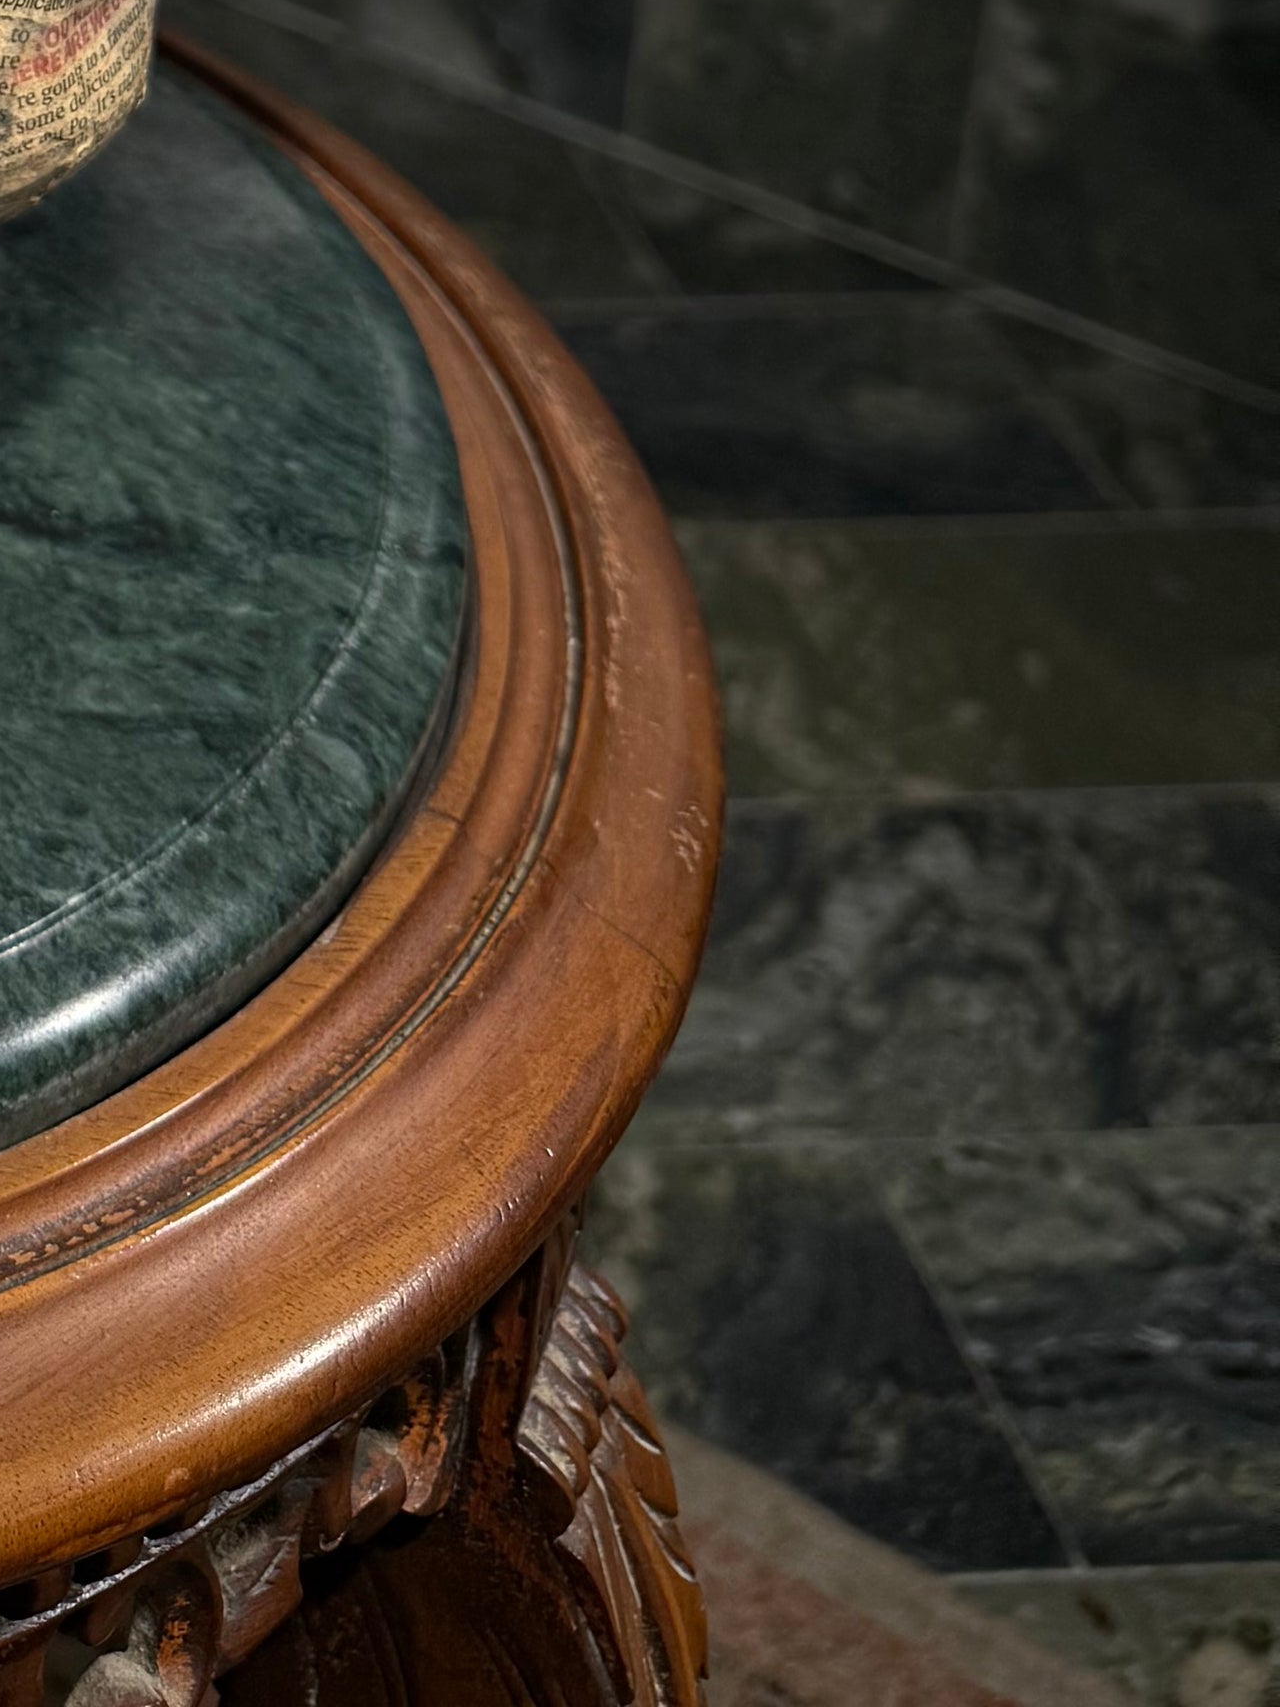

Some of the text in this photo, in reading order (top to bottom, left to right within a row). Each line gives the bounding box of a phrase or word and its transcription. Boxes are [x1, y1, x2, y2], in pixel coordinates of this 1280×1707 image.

[10, 27, 32, 44] to
[16, 59, 124, 134] some delicious
[41, 65, 83, 105] going
